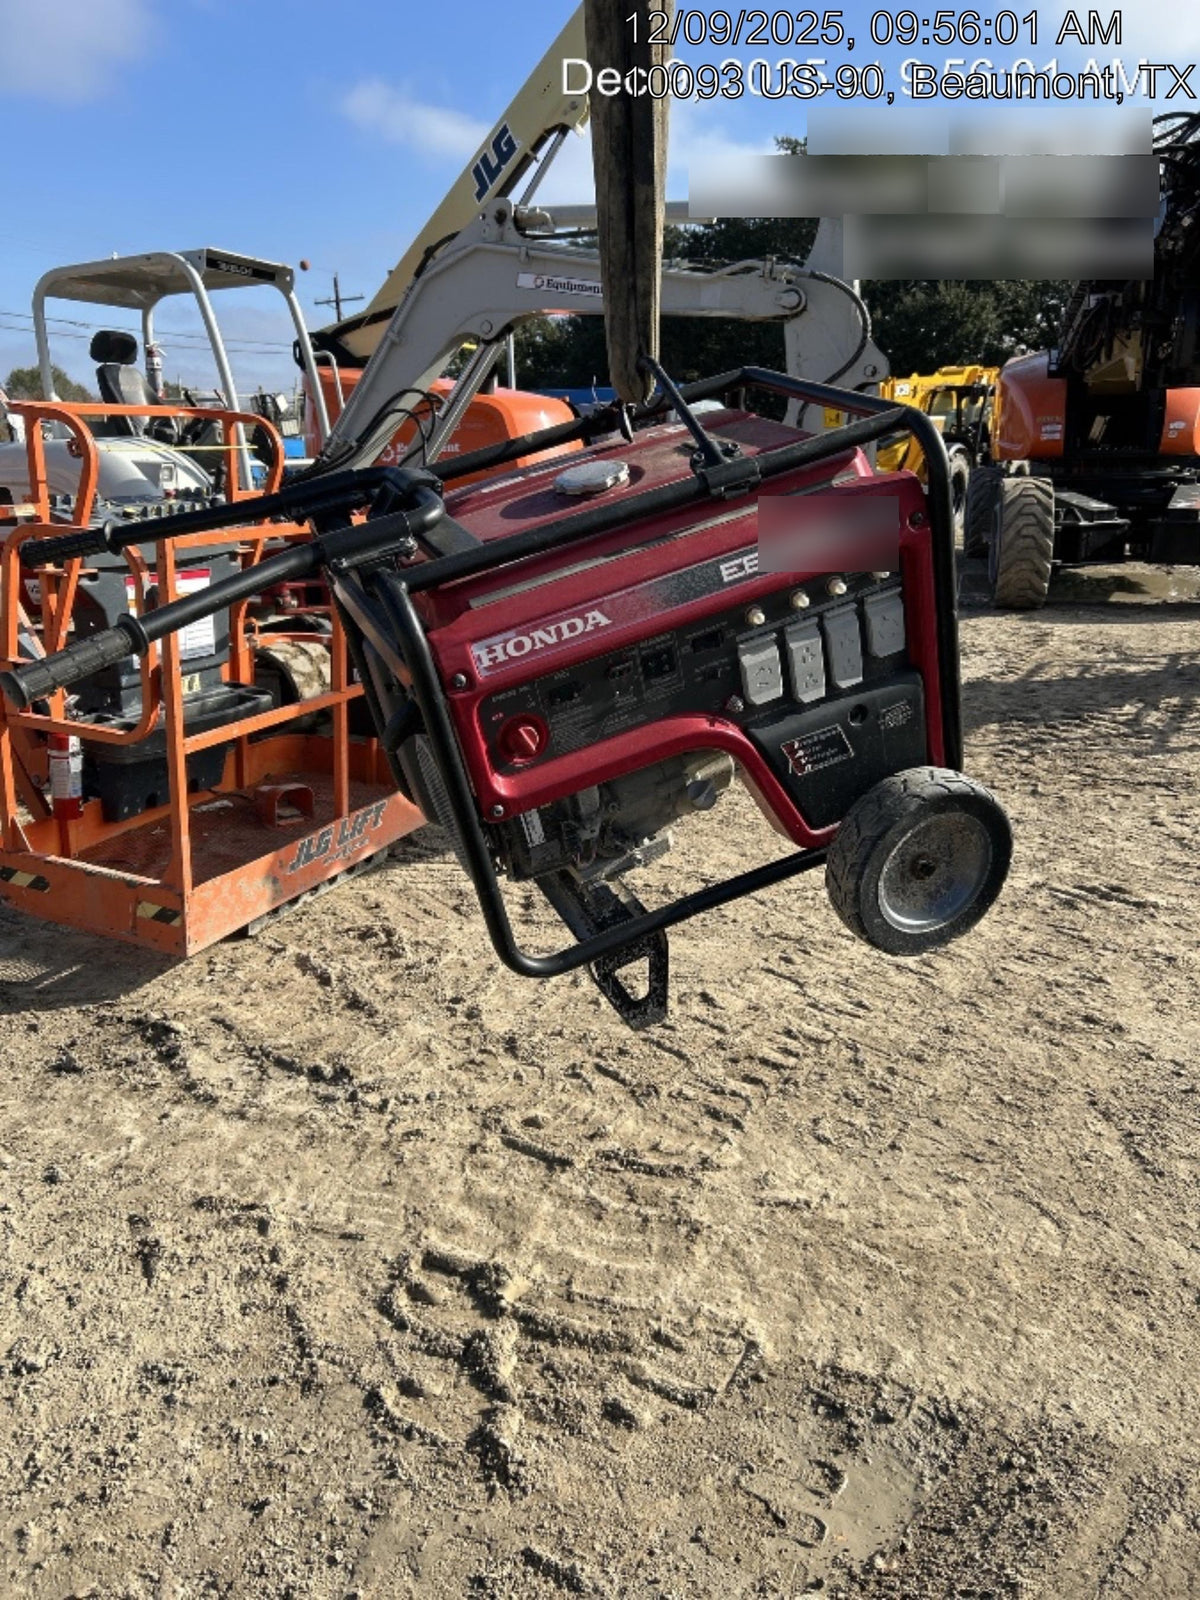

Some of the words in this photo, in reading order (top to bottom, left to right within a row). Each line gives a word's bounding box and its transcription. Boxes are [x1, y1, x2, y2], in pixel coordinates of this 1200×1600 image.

[471, 122, 519, 204] JLG
[476, 608, 613, 668] HONDA
[286, 824, 335, 875] JLG
[336, 799, 388, 849] LIFT
